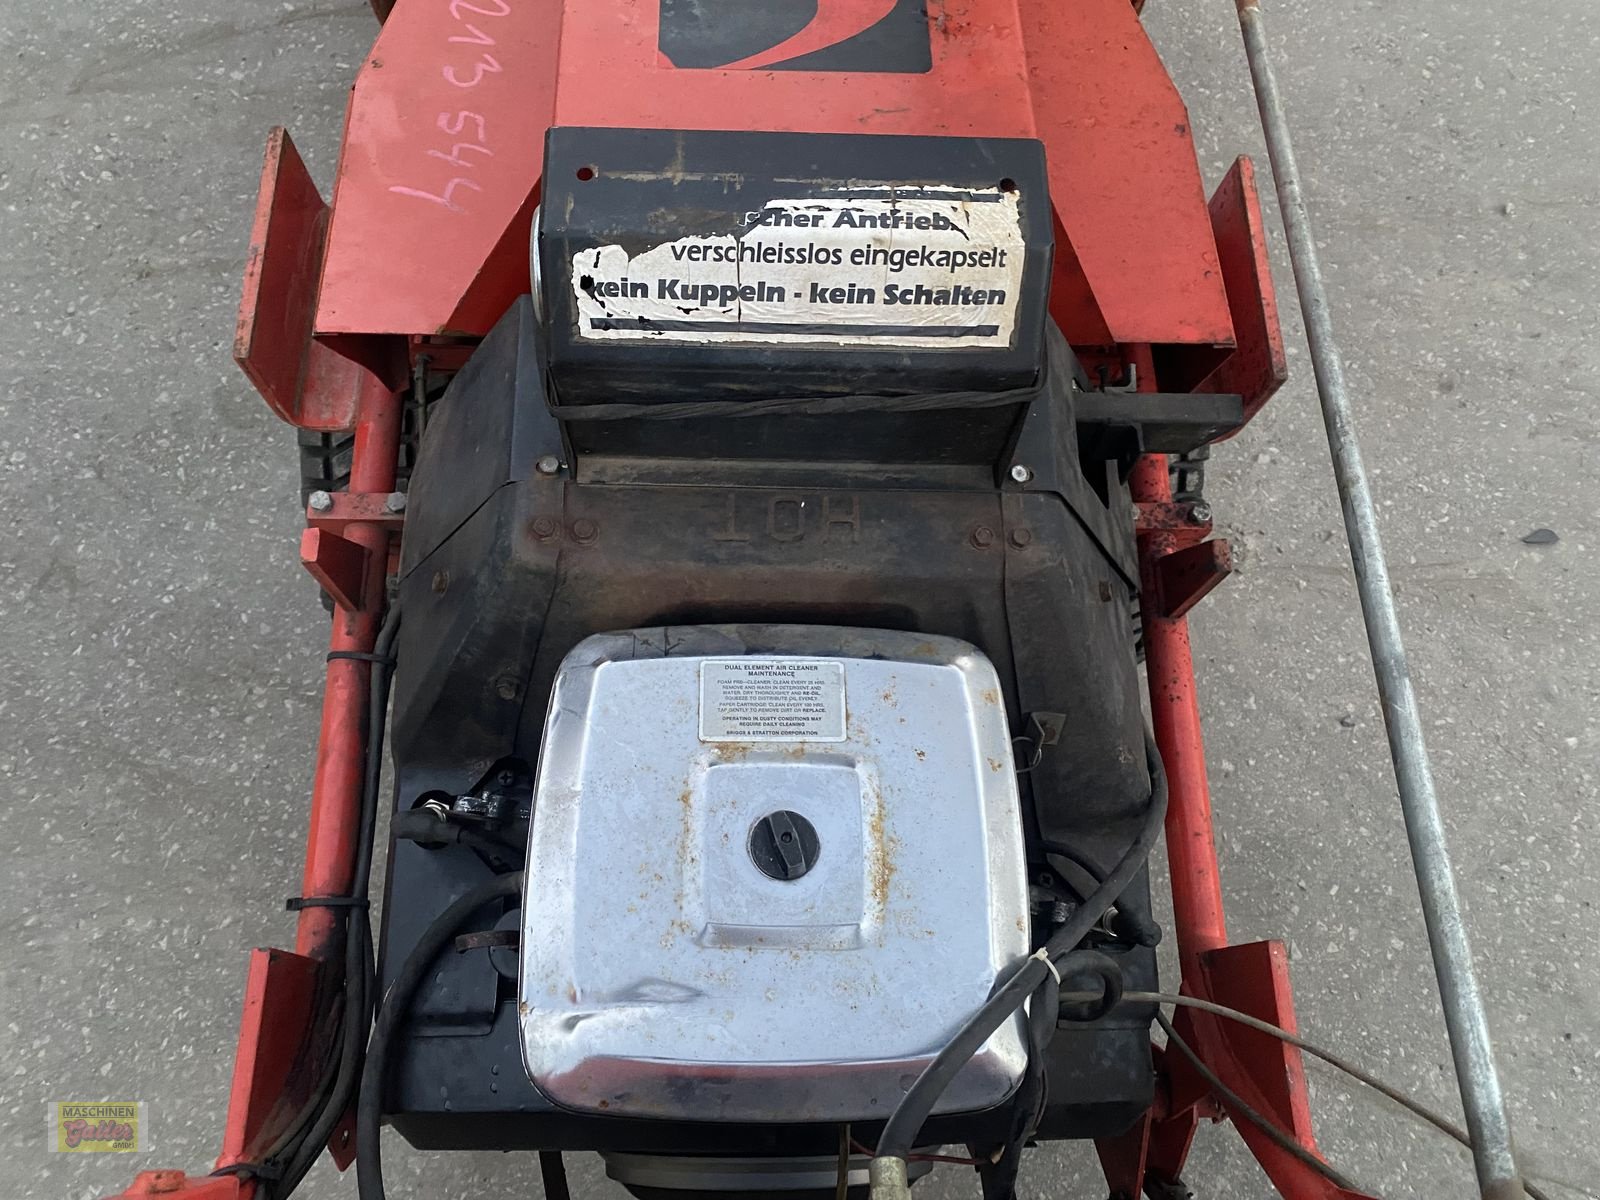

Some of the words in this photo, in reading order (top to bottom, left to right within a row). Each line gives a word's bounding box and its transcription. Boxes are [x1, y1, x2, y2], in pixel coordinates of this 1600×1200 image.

[832, 209, 951, 231] Antrieb
[671, 239, 842, 265] verschleisslos
[850, 246, 1007, 273] eingekapselt
[657, 278, 786, 307] Kuppeln
[810, 282, 875, 304] kein
[883, 283, 1007, 306] Schalten
